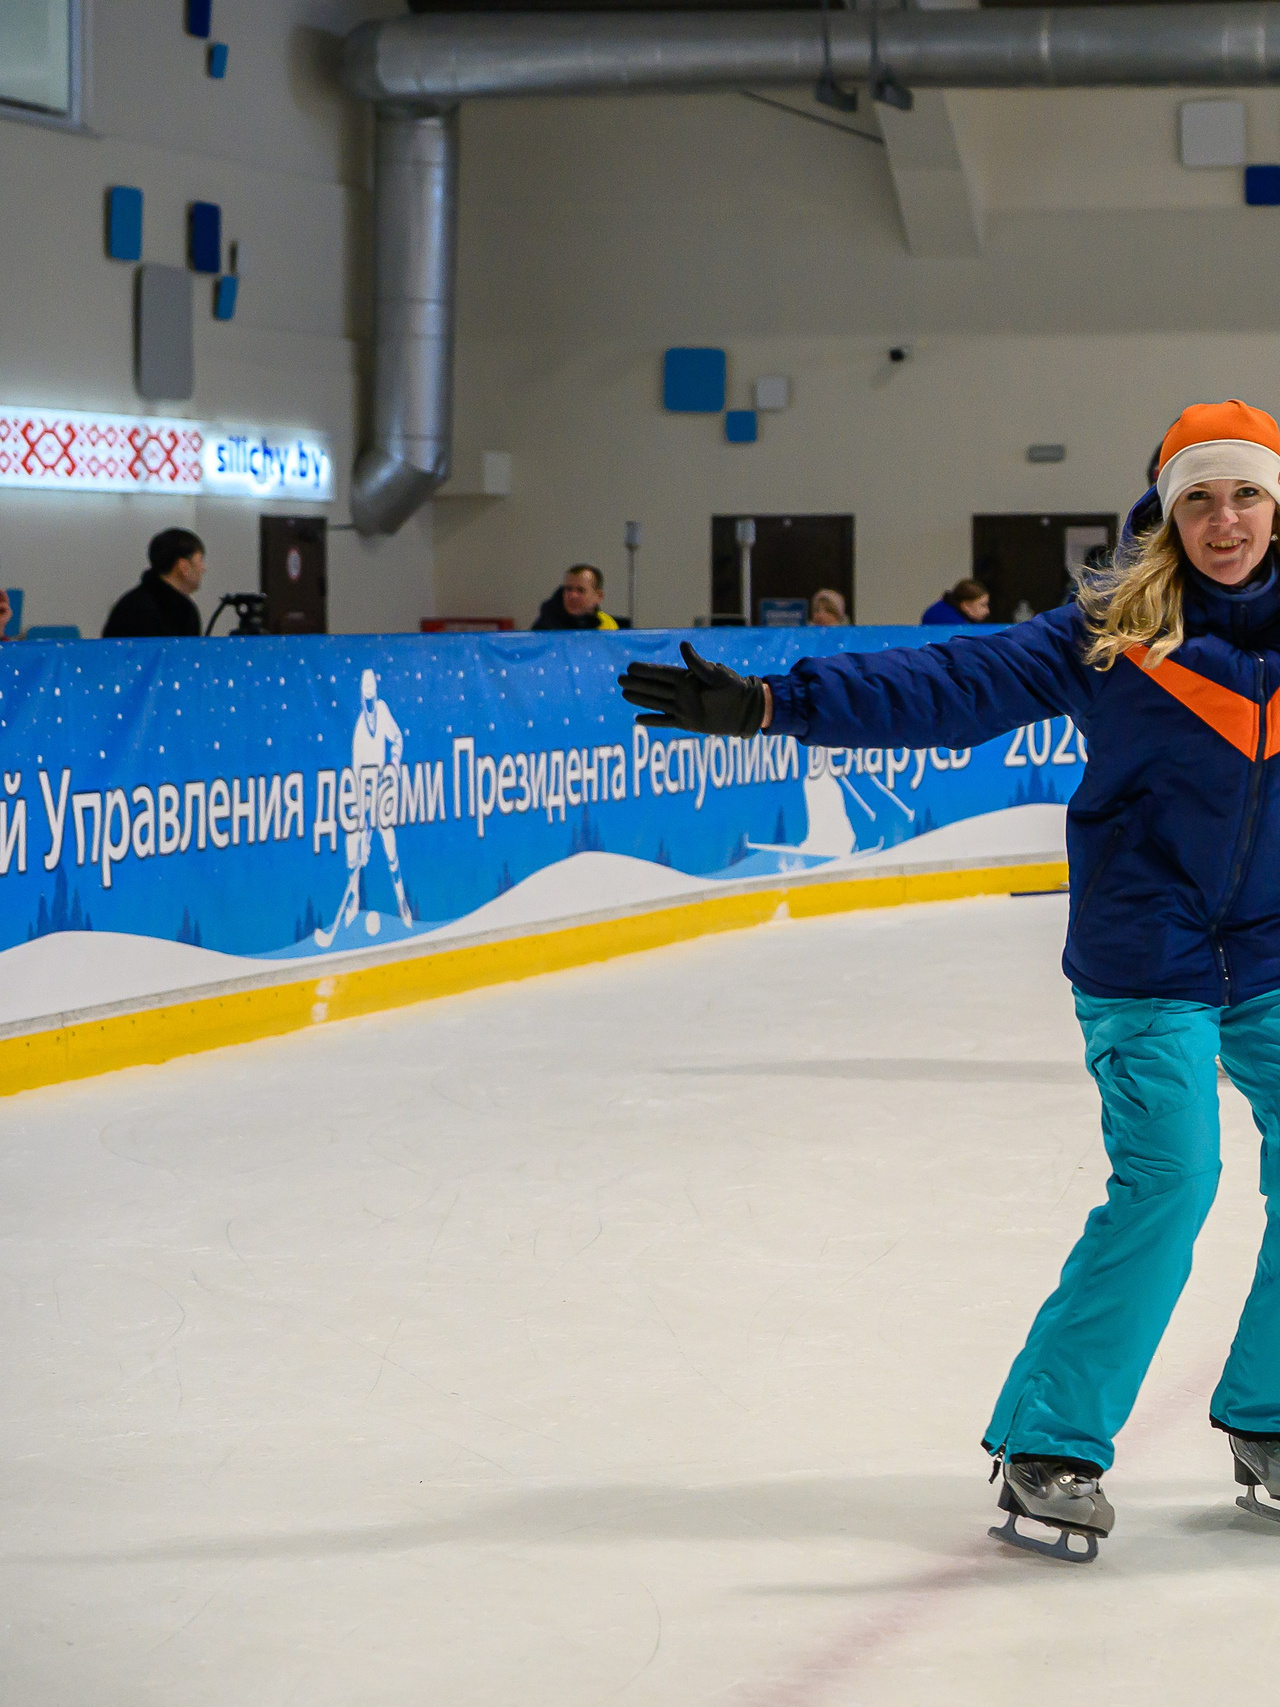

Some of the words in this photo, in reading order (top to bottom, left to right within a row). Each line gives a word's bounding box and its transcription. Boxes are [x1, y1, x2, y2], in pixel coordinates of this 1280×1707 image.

[38, 767, 304, 888] Управления
[312, 759, 446, 855] делами
[452, 736, 626, 838] Президента
[632, 724, 799, 811] Республики
